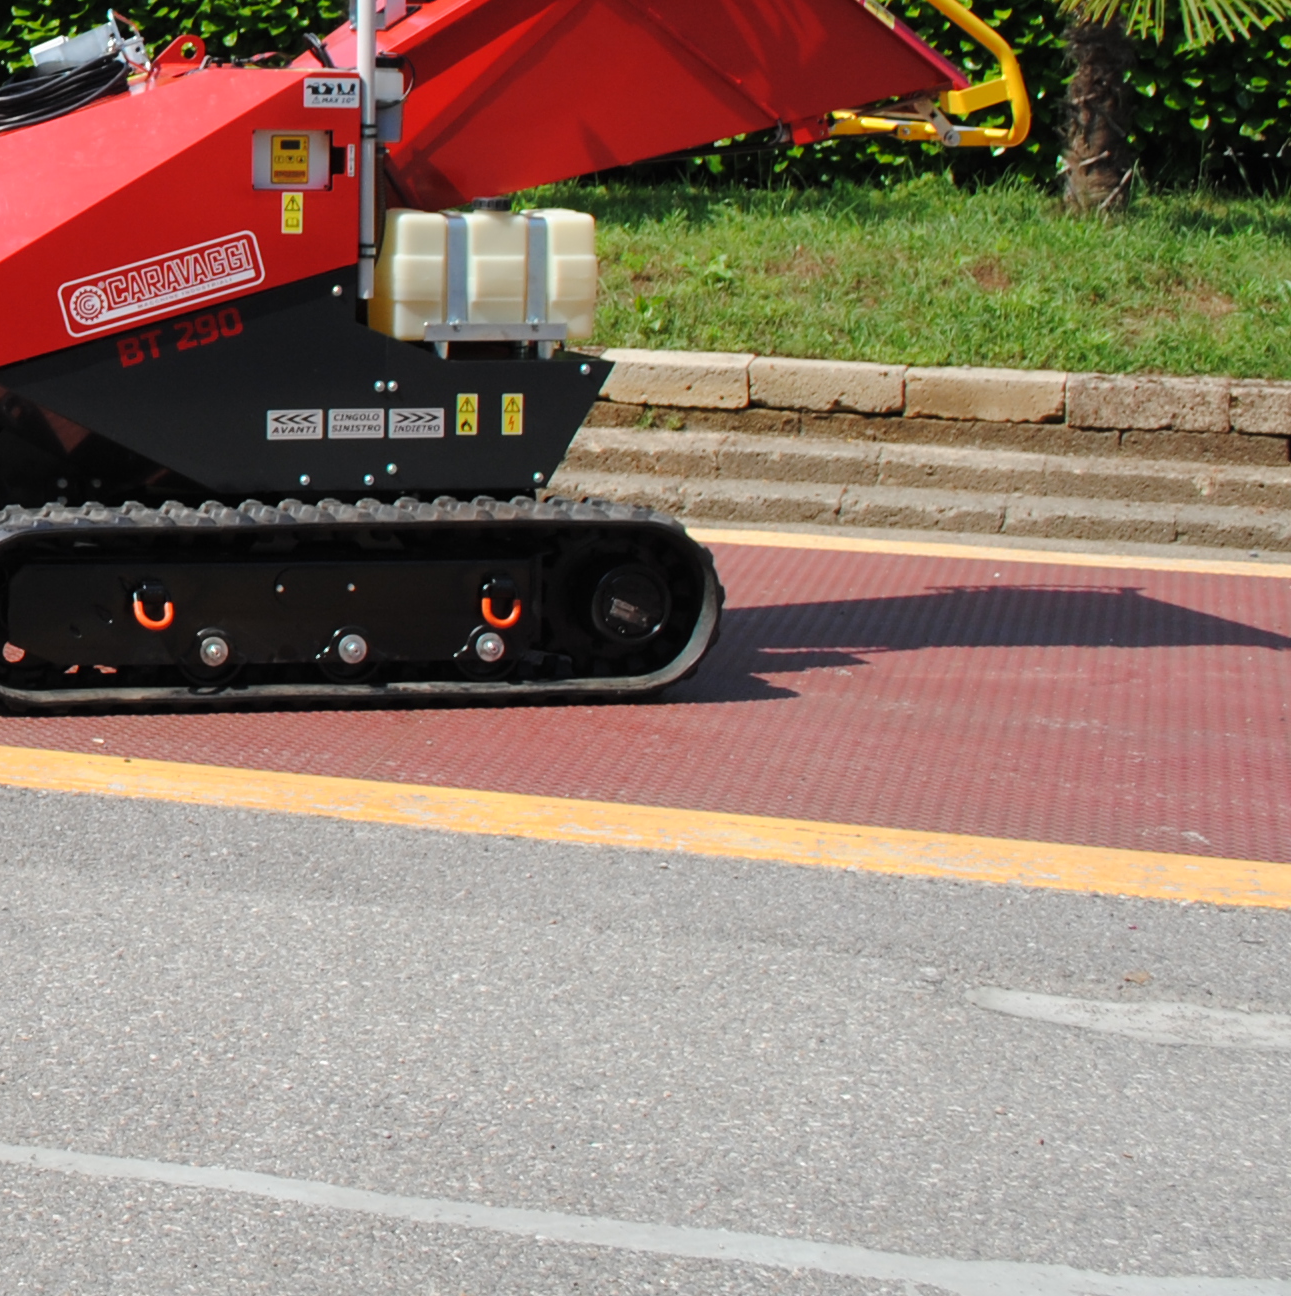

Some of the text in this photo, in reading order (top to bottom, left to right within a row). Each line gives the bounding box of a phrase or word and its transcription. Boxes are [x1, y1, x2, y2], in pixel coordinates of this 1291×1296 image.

[105, 239, 254, 308] CARAVAGGI
[116, 307, 244, 368] BT 290
[333, 413, 380, 421] CINGOLO
[271, 425, 318, 434] AVANTI
[331, 424, 381, 432] SINISTRO
[393, 424, 440, 433] INDIETRO
